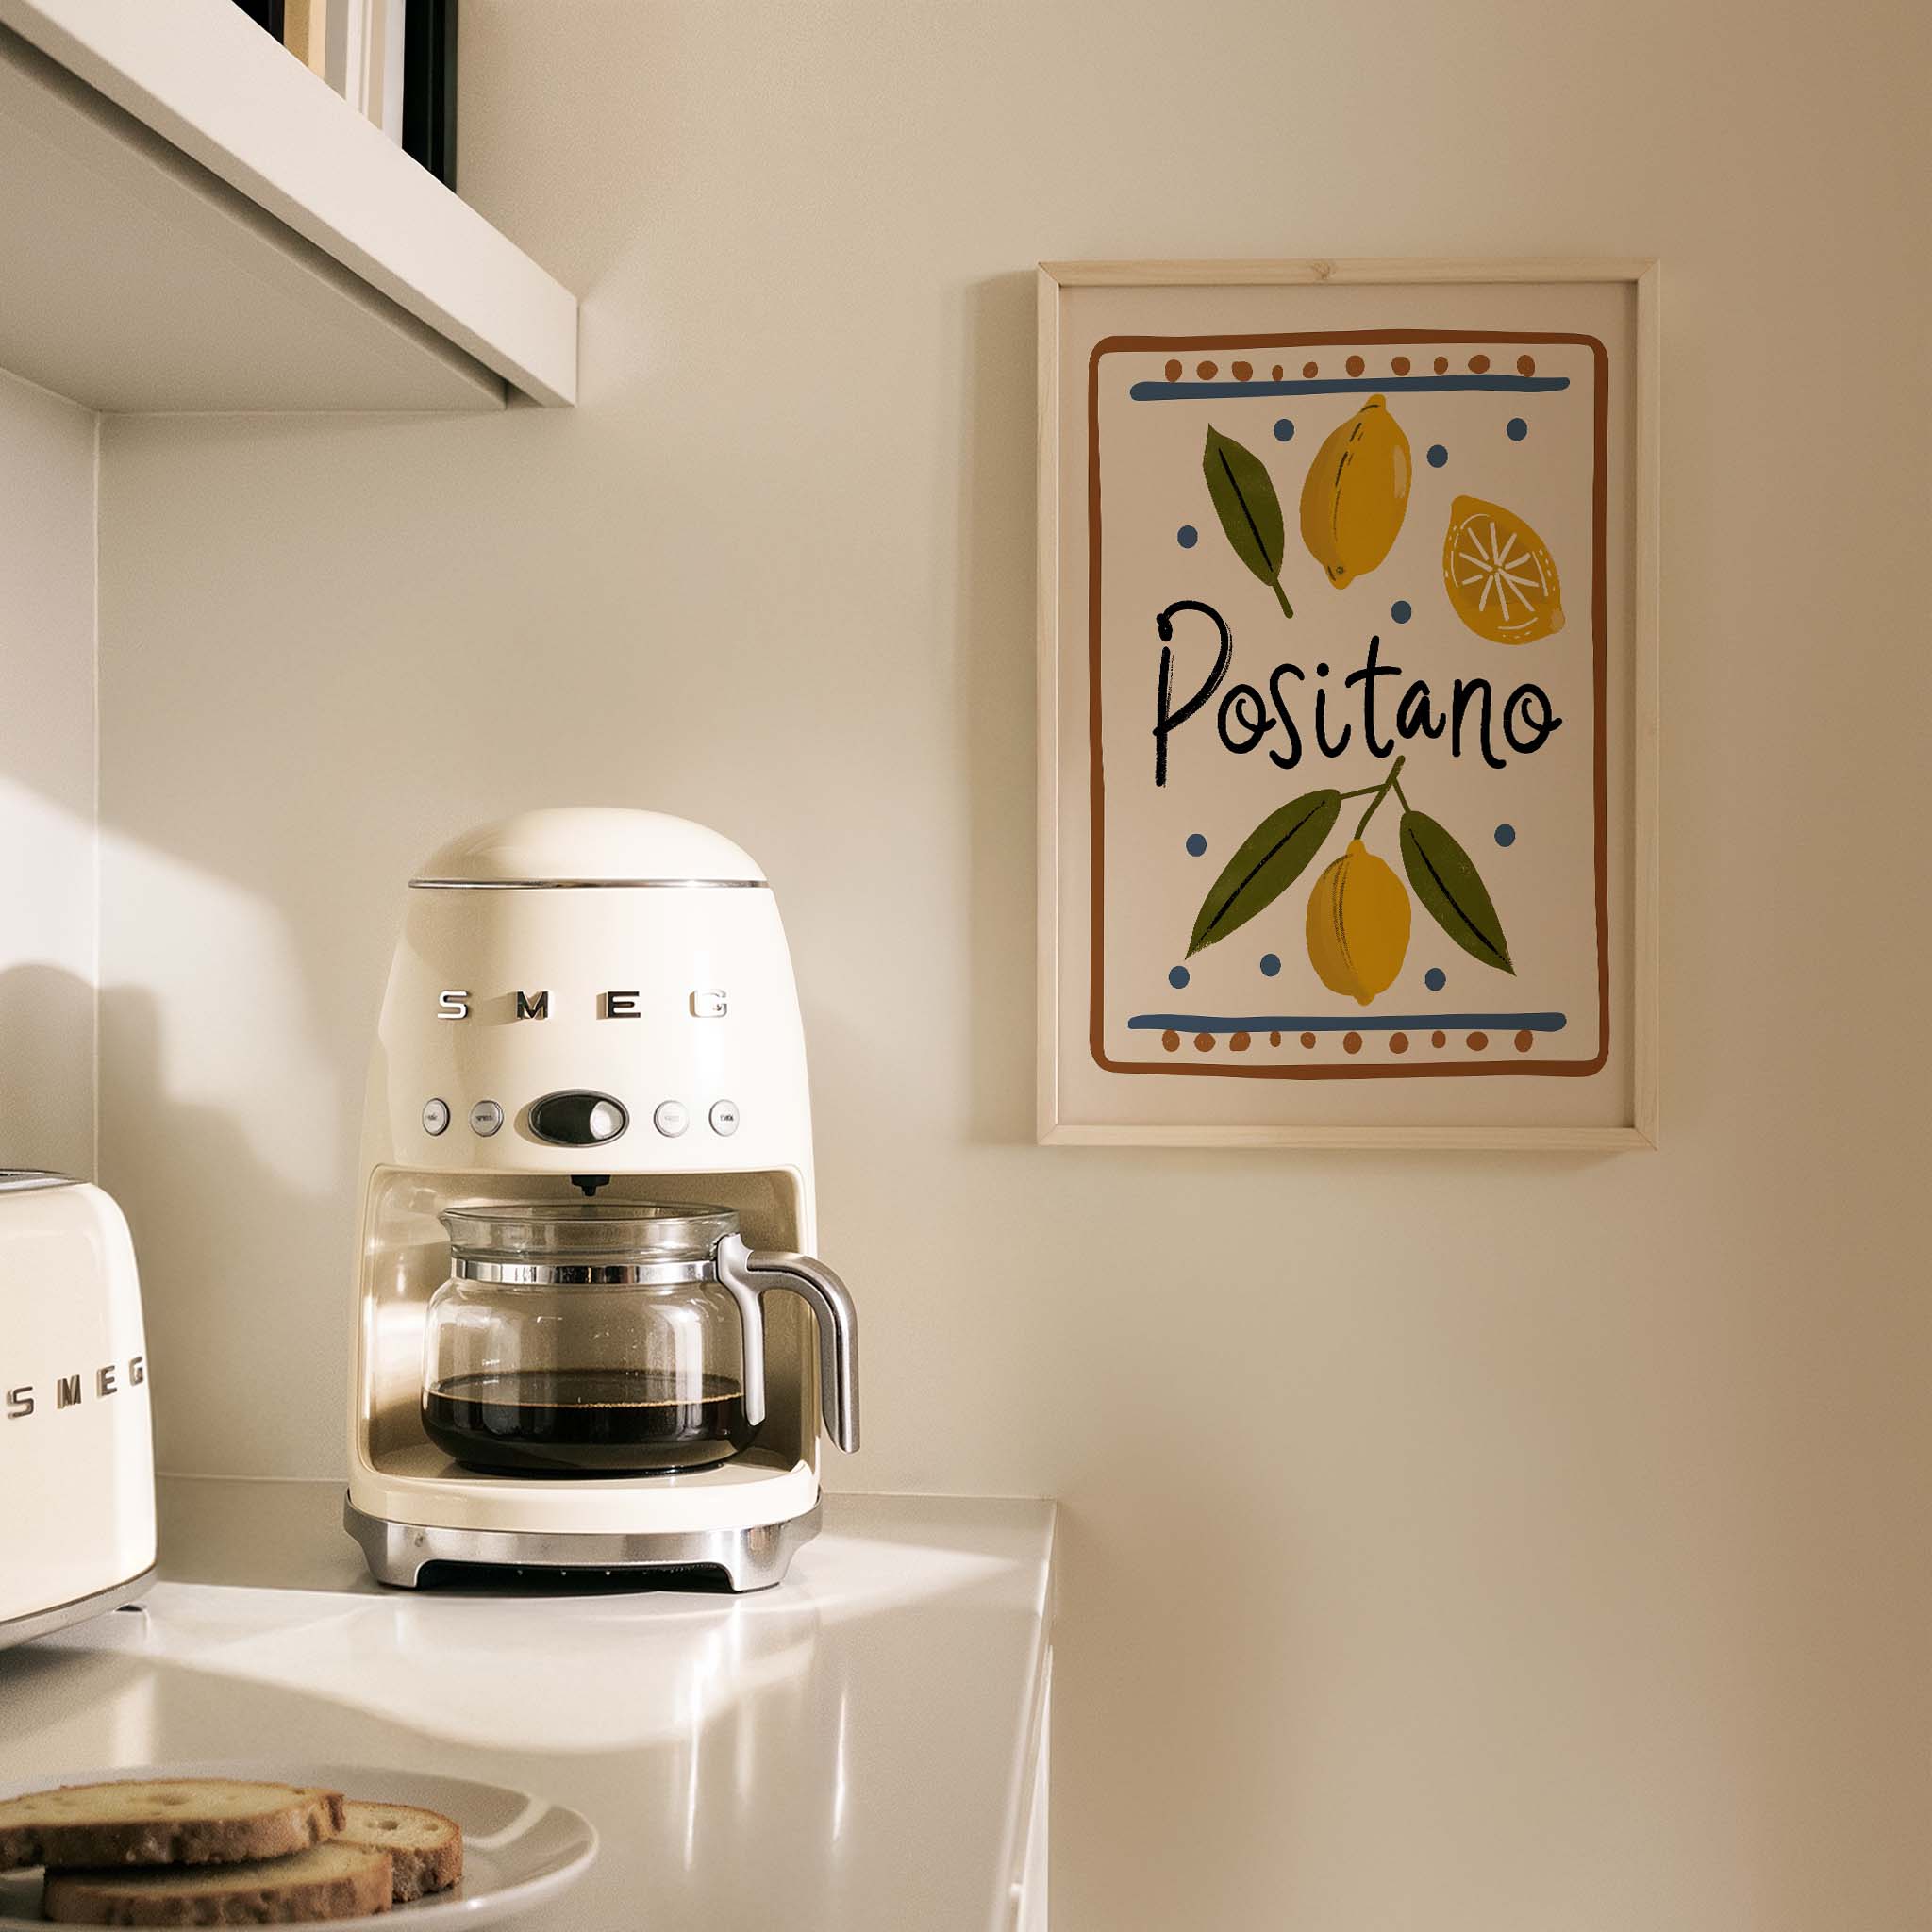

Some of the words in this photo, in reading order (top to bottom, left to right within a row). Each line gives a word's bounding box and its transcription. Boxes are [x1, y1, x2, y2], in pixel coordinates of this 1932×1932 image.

[1152, 600, 1563, 787] Positano
[437, 990, 728, 1020] SMEG
[6, 1356, 144, 1419] SMEG
